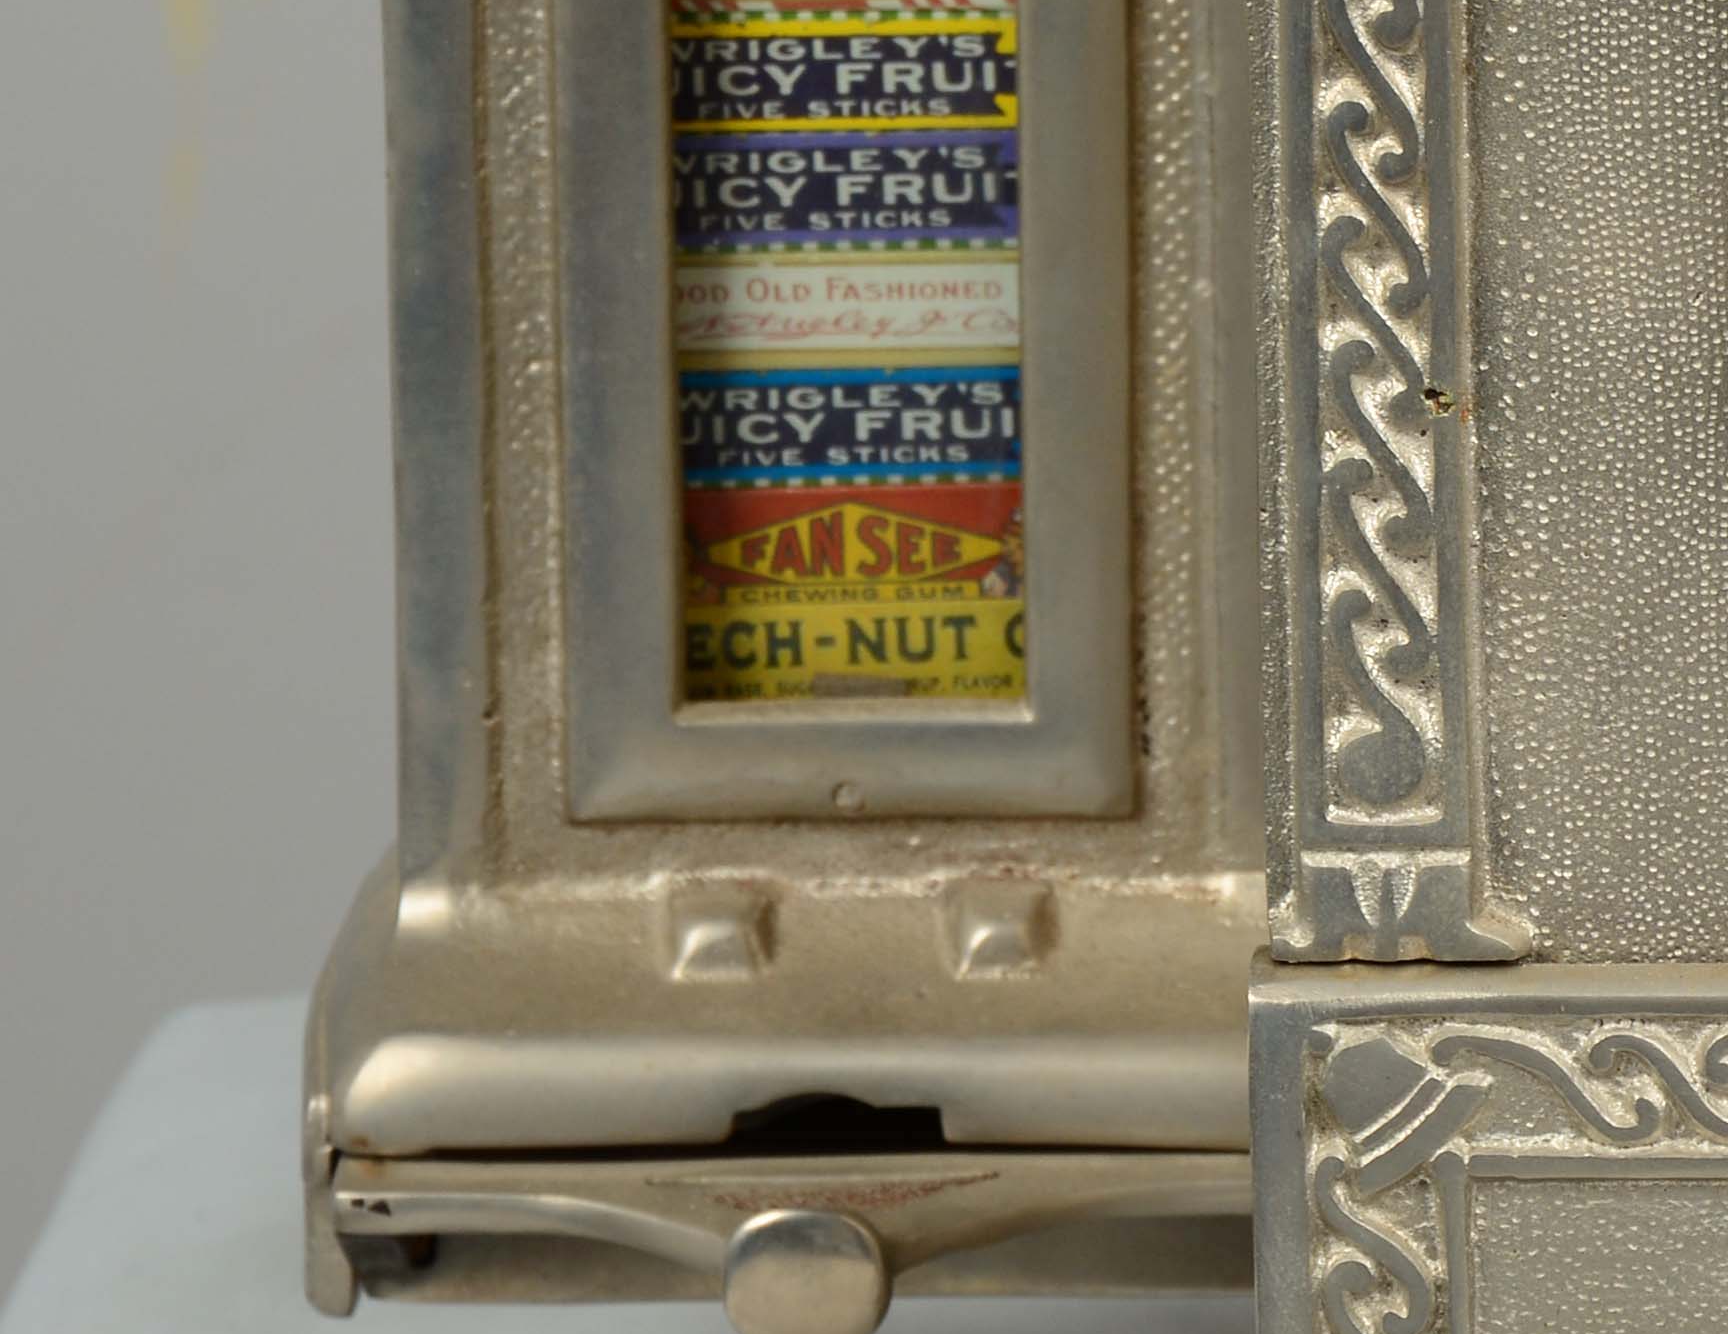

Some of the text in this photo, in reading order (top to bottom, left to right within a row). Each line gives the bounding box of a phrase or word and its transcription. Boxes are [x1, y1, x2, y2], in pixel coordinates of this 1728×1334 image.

[836, 60, 1015, 94] FRUI
[699, 97, 950, 120] FIVE STICKS
[837, 171, 1016, 207] FRUI
[699, 208, 952, 232] FIVE STICKS
[745, 275, 1004, 305] OLD FASHIONED
[682, 382, 1002, 412] WRIGLEY'S
[717, 443, 970, 467] FIVE STICKS
[741, 585, 964, 604] CHEWING GUM
